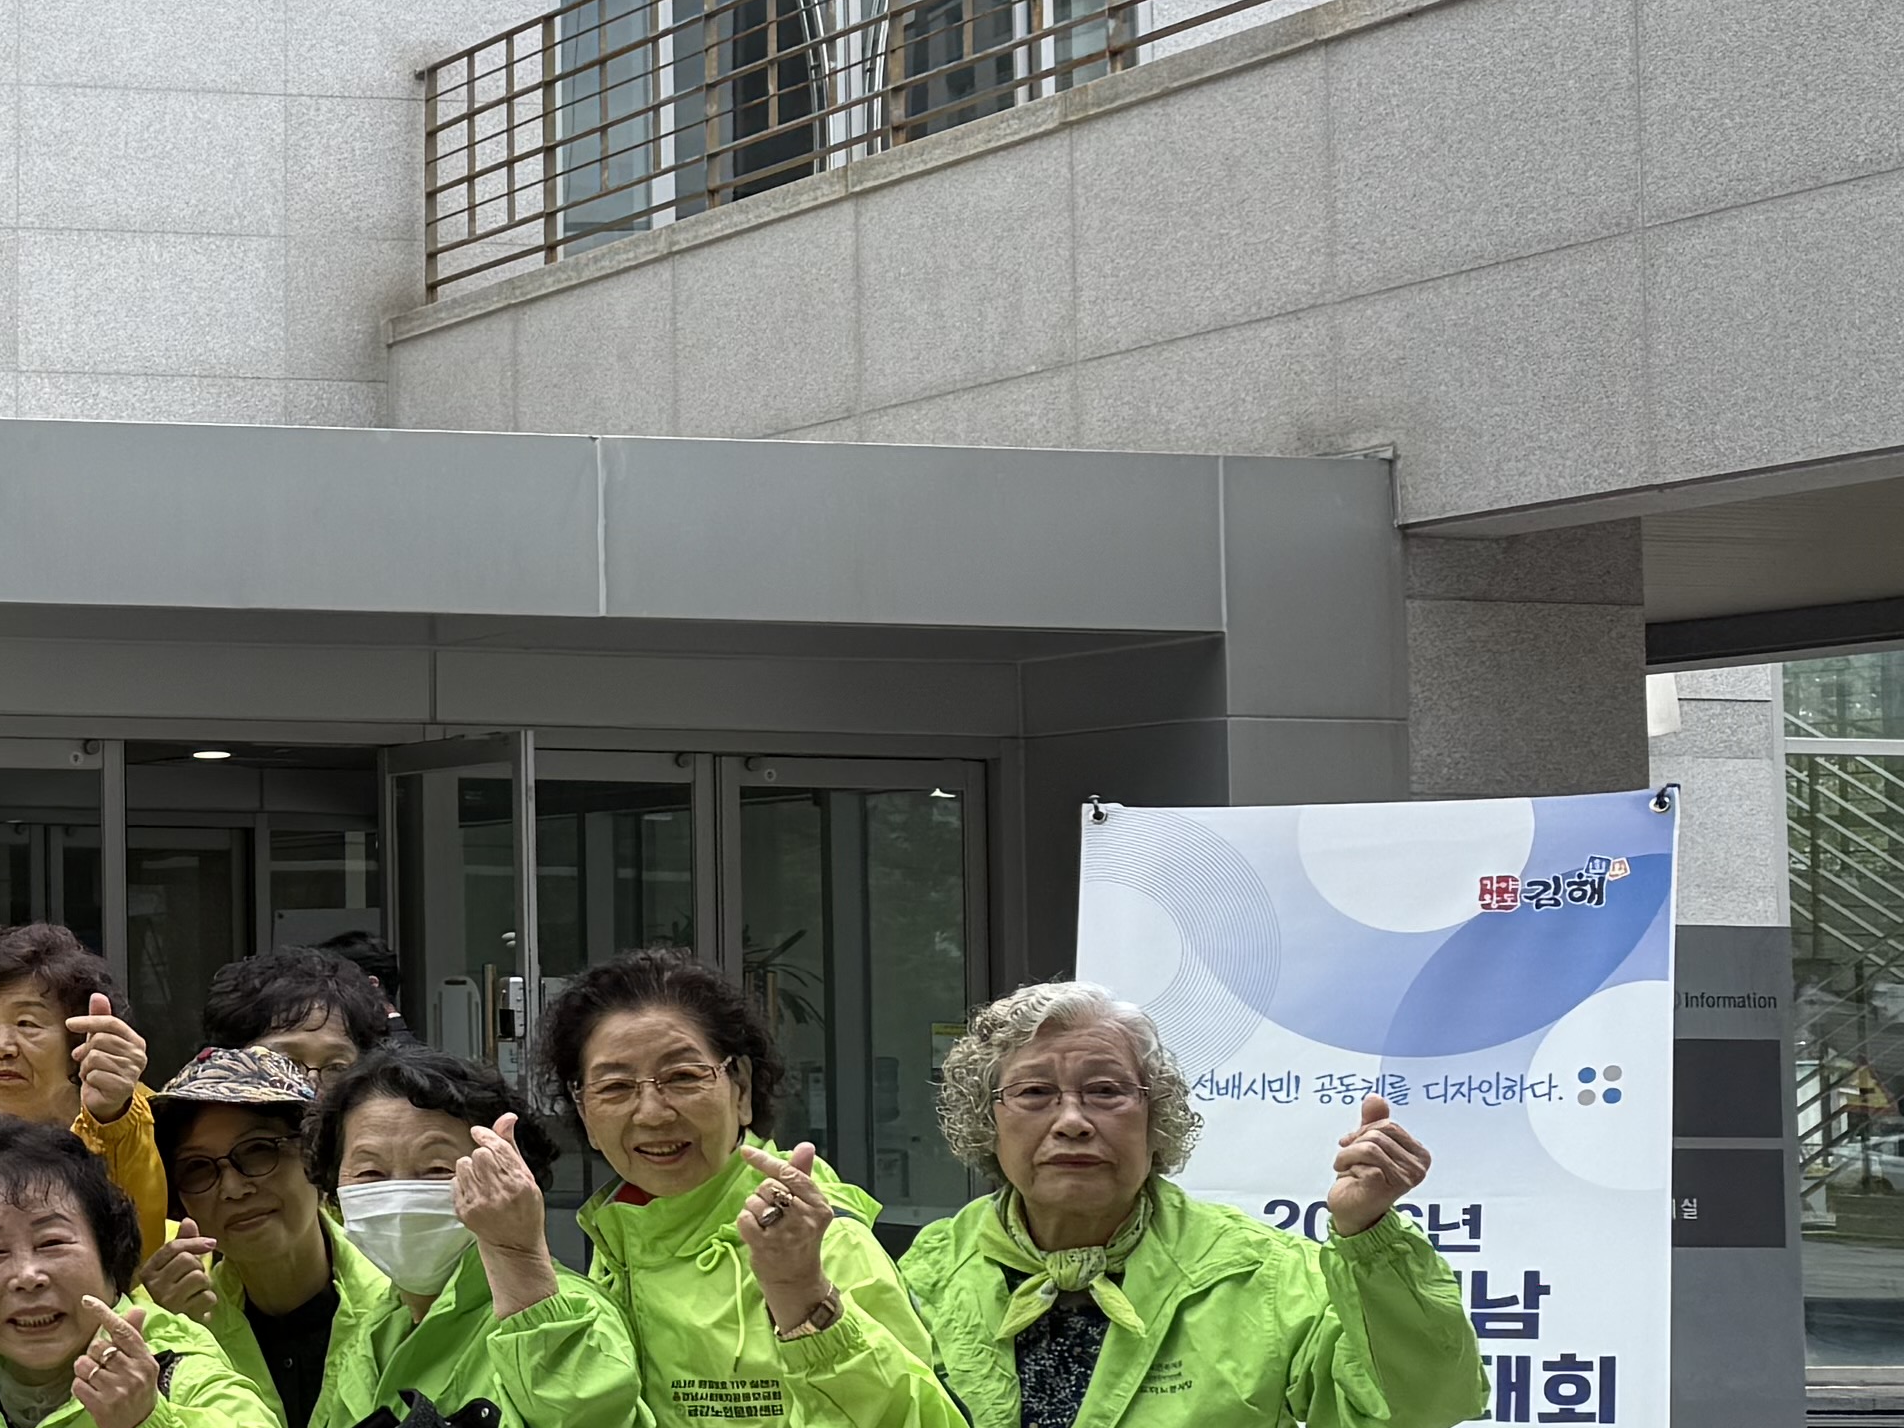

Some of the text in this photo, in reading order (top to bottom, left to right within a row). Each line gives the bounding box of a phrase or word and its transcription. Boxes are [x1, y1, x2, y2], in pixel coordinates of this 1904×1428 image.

[1523, 872, 1605, 910] 김해
[1683, 992, 1778, 1010] Information
[1191, 1069, 1301, 1105] 선배시민!
[1424, 1071, 1564, 1107] 디자인하다.
[1264, 1199, 1483, 1253] 20년
[1455, 1270, 1551, 1340] 남
